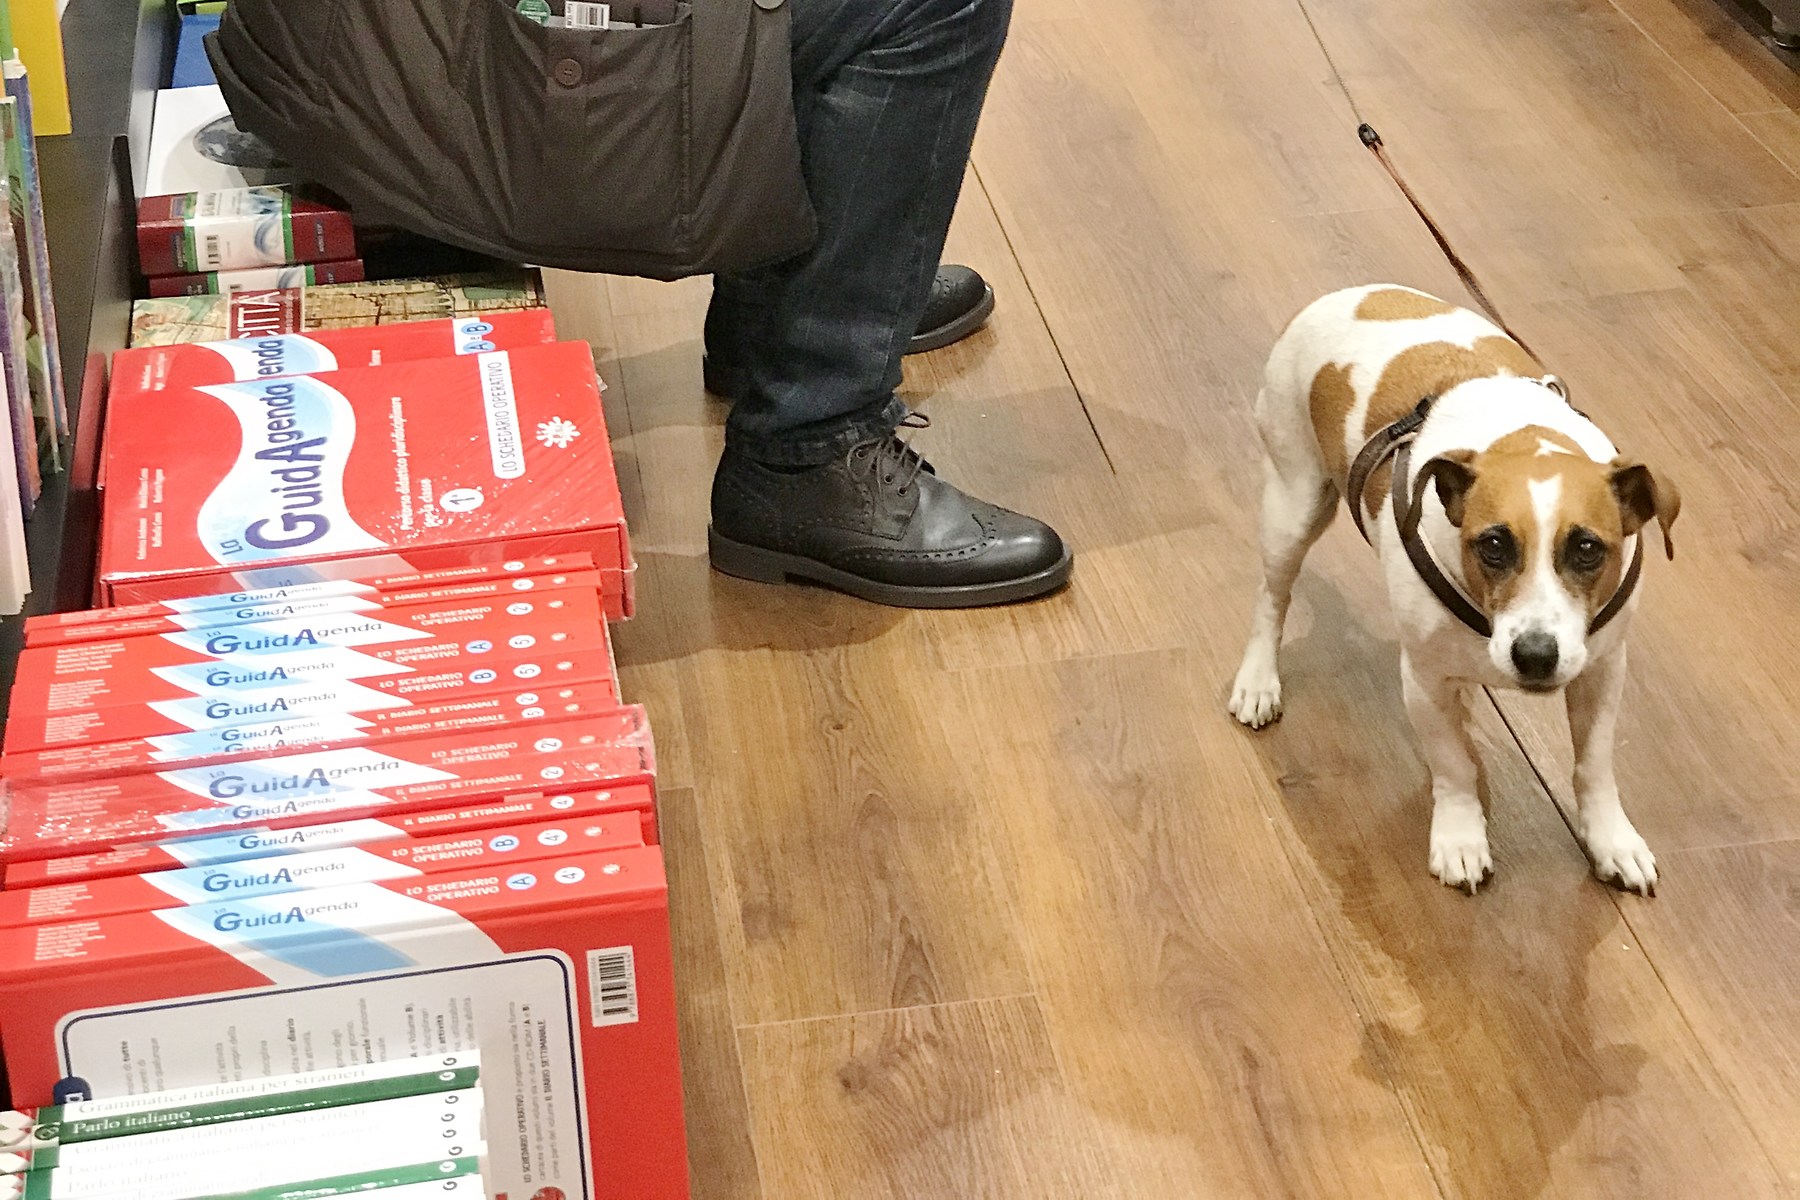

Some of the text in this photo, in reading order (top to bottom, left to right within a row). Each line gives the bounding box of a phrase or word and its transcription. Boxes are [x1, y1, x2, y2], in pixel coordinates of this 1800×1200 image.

[467, 325, 488, 333] B
[487, 361, 518, 473] LO SCHEDARIO OPERATIVO
[245, 383, 331, 549] GuidAgenda
[394, 457, 411, 494] didattico
[387, 575, 420, 584] DIARIO
[423, 567, 489, 579] SETTIMANALE
[394, 591, 429, 601] DIARIO
[431, 585, 497, 598] SETTIMANALE
[236, 602, 329, 619] GuidAgenda
[421, 613, 484, 626] OPERATIVO
[429, 606, 492, 619] SCHEDARIO
[206, 623, 382, 654] GuidAgenda
[394, 649, 460, 663] OPERATIVO
[395, 642, 459, 656] SCHEDARIO
[206, 661, 334, 687] GuidAgenda
[397, 672, 463, 686] SCHEDARIO
[398, 679, 464, 693] OPERATIVO
[206, 692, 336, 719] GuidAgenda
[390, 708, 426, 719] DIARIO
[430, 700, 499, 714] SETTIMANALE
[221, 721, 320, 741] GuidAgenda
[395, 722, 431, 733] DIARIO
[434, 714, 506, 727] SETTIMANALE
[441, 750, 510, 764] OPERATIVO
[450, 742, 518, 755] SCHEDARIO
[209, 761, 400, 798] GuidAgenda
[409, 783, 447, 794] DIARIO
[450, 774, 523, 788] SETTIMANALE
[232, 796, 336, 819] GuidAgenda
[418, 813, 456, 824] DIARIO
[459, 804, 533, 818] SETTIMANALE
[240, 826, 344, 849] GuidAgenda
[412, 839, 483, 854] SCHEDARIO
[412, 847, 484, 863] OPERATIVO
[203, 862, 345, 892] GuidAgenda
[426, 877, 499, 893] SCHEDARIO
[427, 886, 499, 901] OPERATIVO
[214, 901, 358, 931] GuidAgenda
[287, 1018, 296, 1041] diario
[121, 1040, 130, 1062] tutte
[541, 1067, 552, 1094] DIARIO
[79, 1069, 366, 1113] Grammatica italiana per stranieri
[72, 1109, 191, 1135] Parlo italiano
[516, 1094, 527, 1134] OPERATIVO
